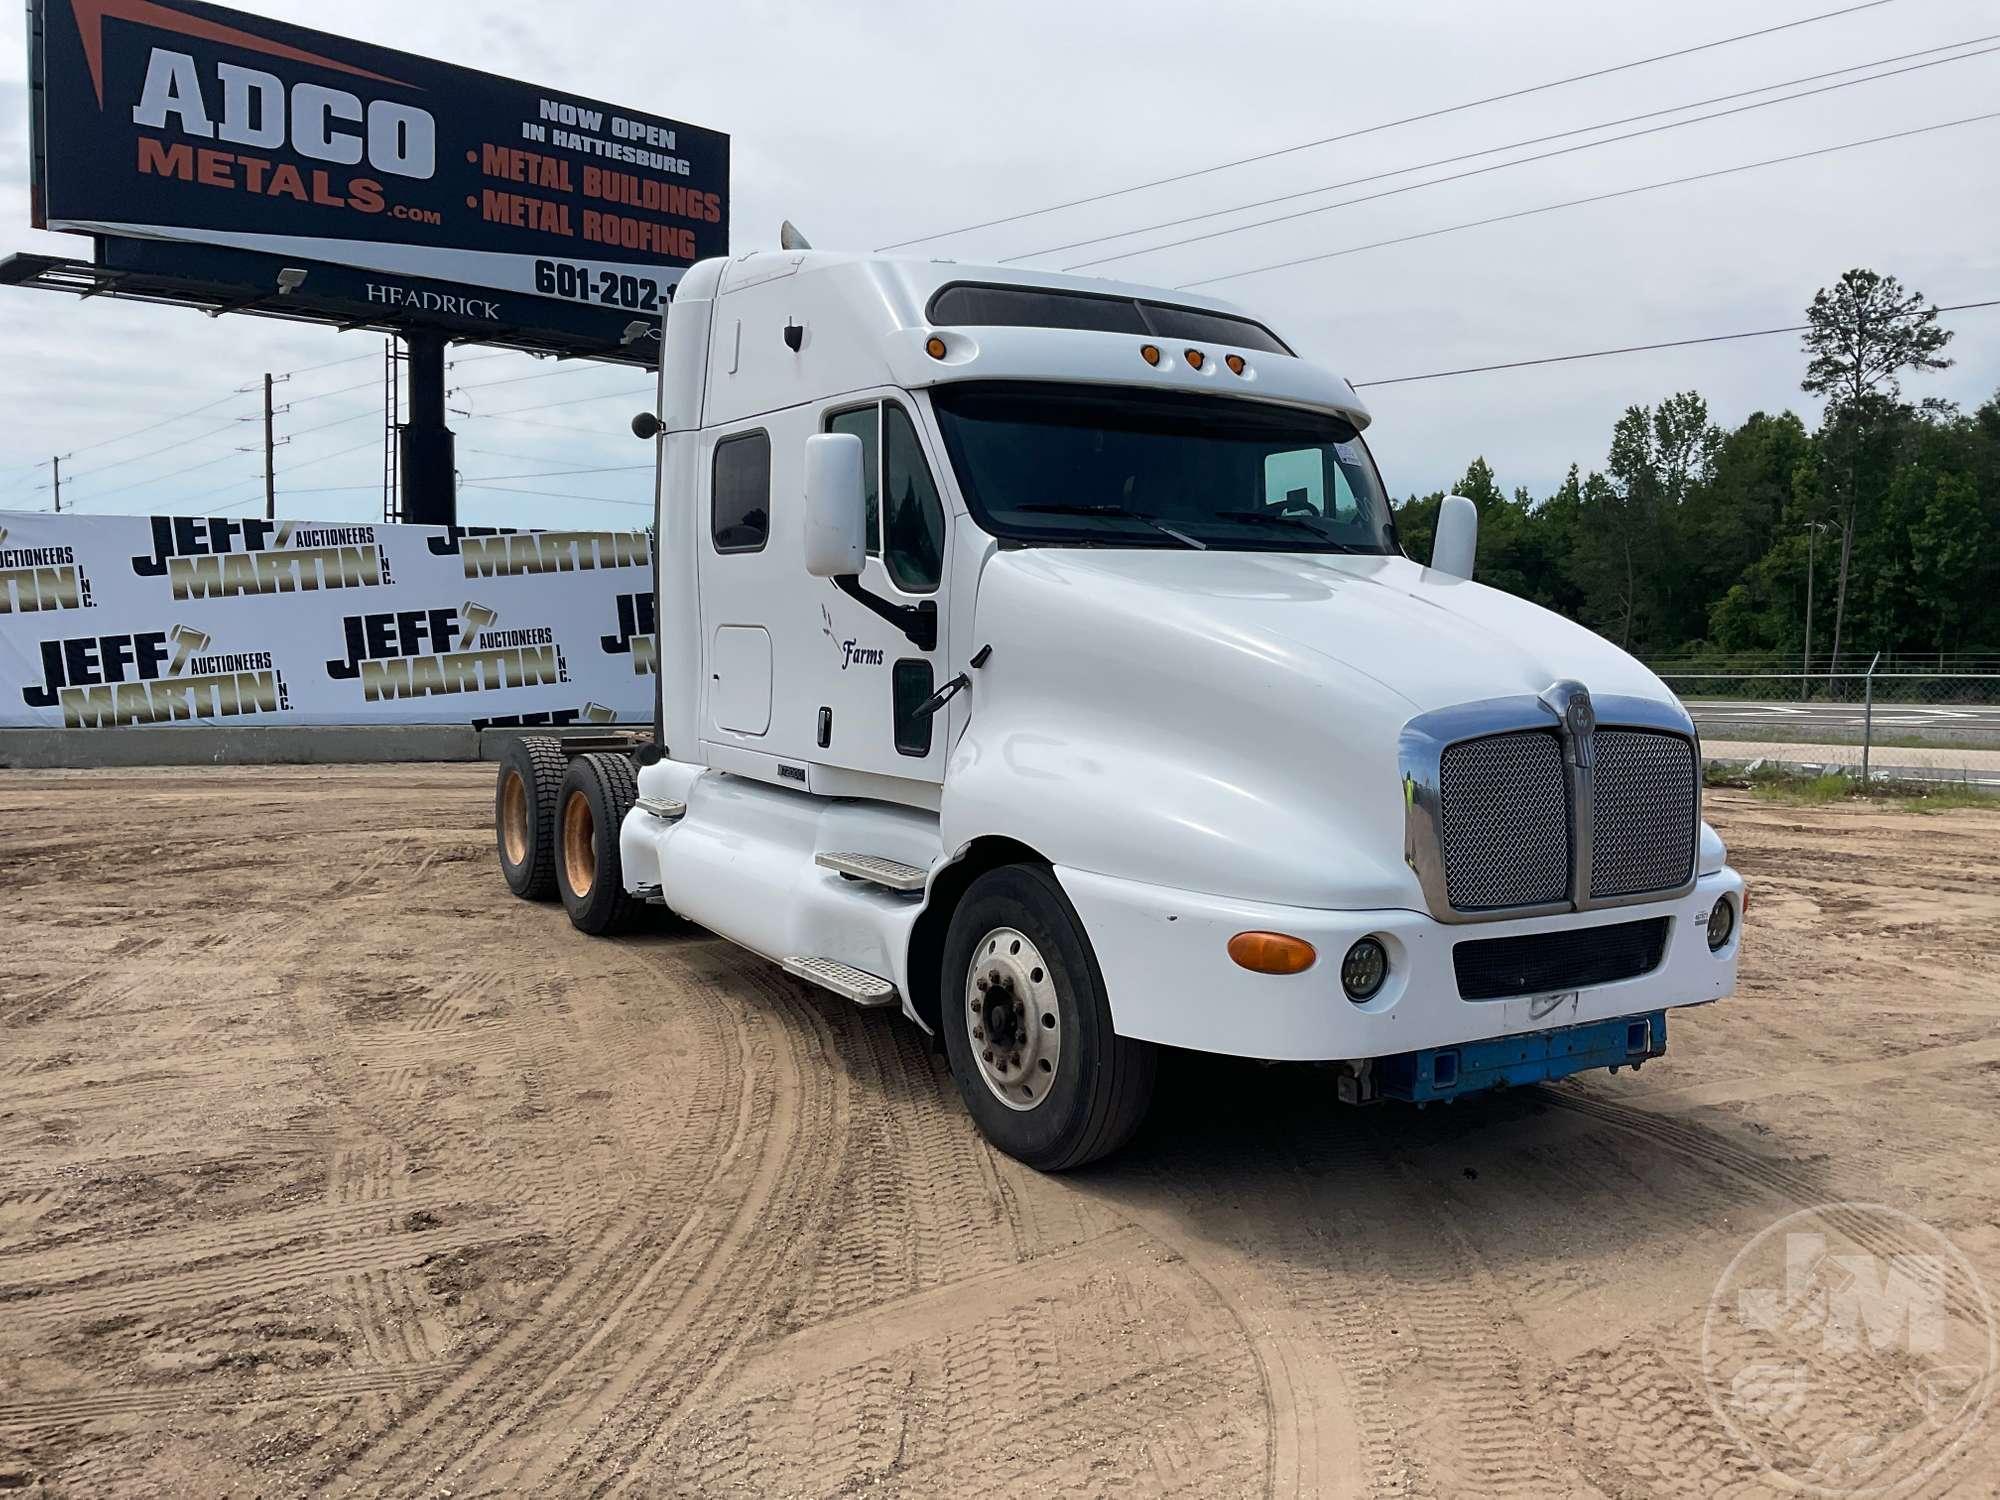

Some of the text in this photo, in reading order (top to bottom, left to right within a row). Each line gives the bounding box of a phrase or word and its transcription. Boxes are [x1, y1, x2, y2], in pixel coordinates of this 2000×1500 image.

[133, 47, 436, 180] ADCO
[540, 99, 676, 150] NOW OPEN
[522, 121, 690, 177] IN HATTIESBURG
[482, 143, 721, 224] METAL BUILDINGS
[482, 189, 696, 260] METAL ROOFING
[365, 283, 501, 320] HEADRICK
[296, 526, 375, 549] AUCTIONEERS
[461, 531, 649, 579] MARTIN
[168, 545, 380, 601] MARTIN
[191, 651, 272, 676] AUCTIONEERS
[326, 608, 460, 680] JEFF
[479, 627, 553, 650] AUCTIONEERS
[842, 638, 884, 670] Farms
[22, 631, 169, 708] JEFF
[361, 644, 557, 702] MARTIN
[60, 670, 278, 730] MARTIN
